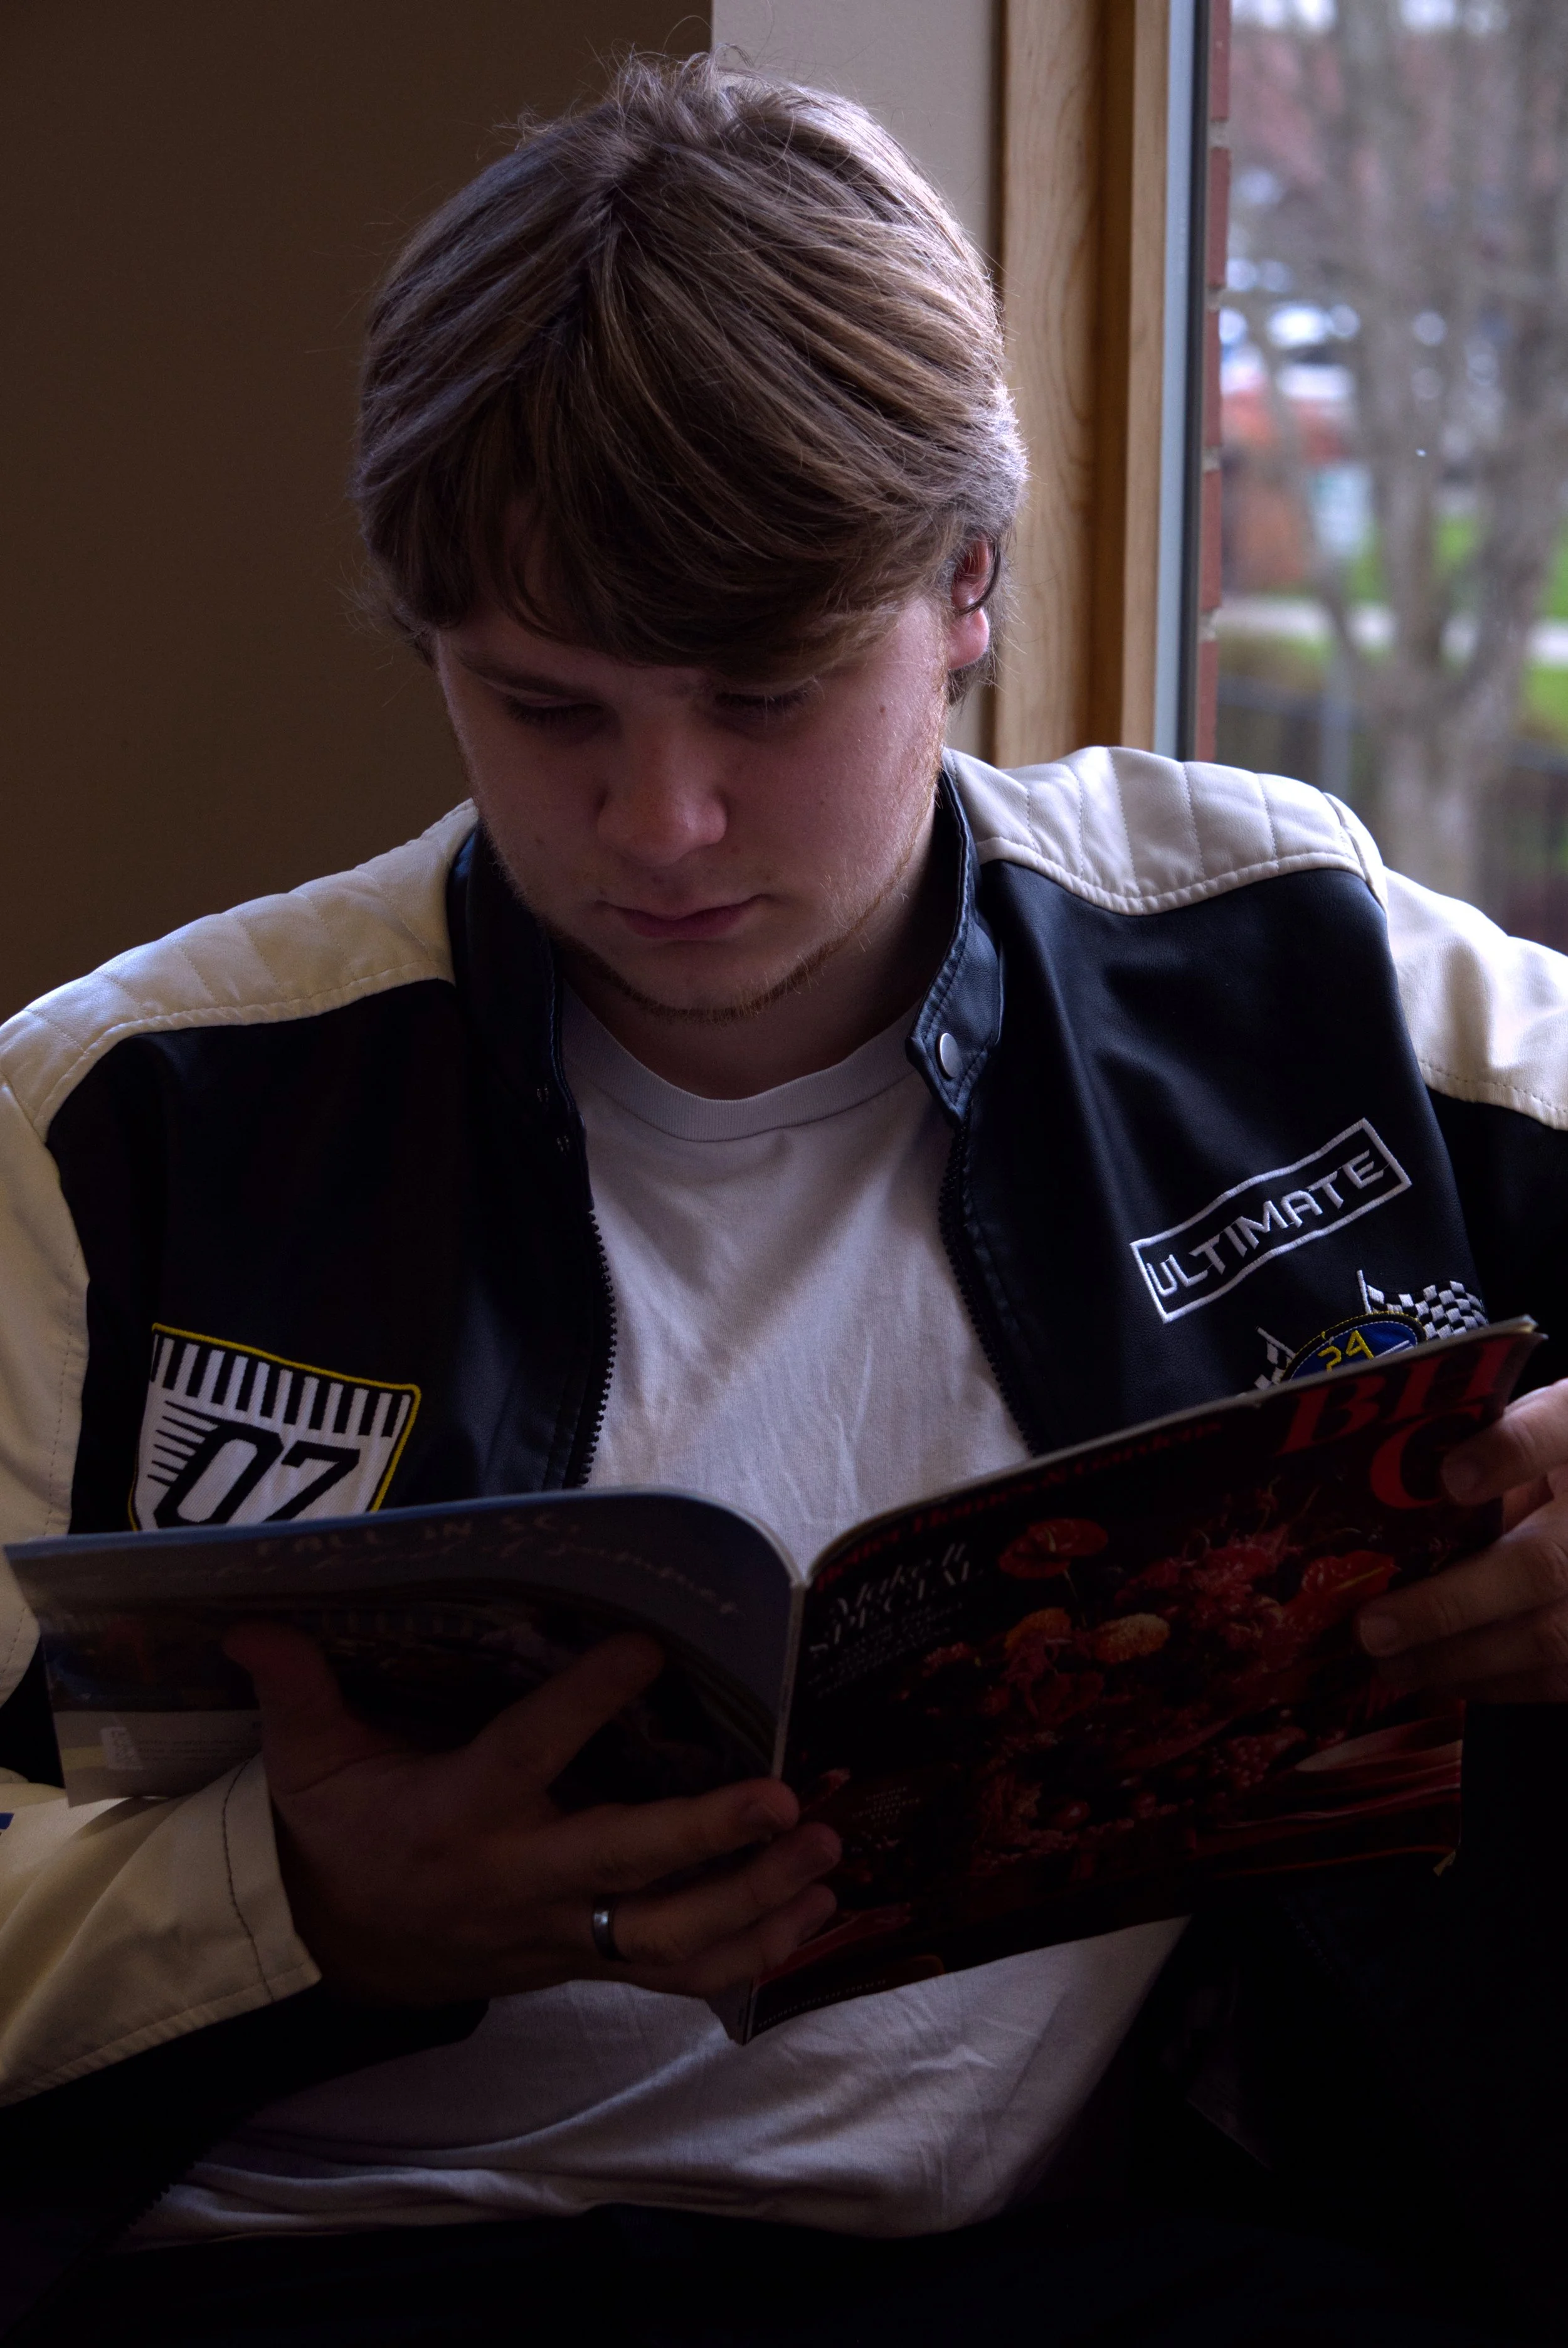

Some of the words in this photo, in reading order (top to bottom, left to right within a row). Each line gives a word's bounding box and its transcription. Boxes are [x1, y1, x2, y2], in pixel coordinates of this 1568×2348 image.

[1147, 1149, 1386, 1298] ULTIMATE
[1317, 1329, 1375, 1374] 24
[153, 1421, 361, 1529] 07
